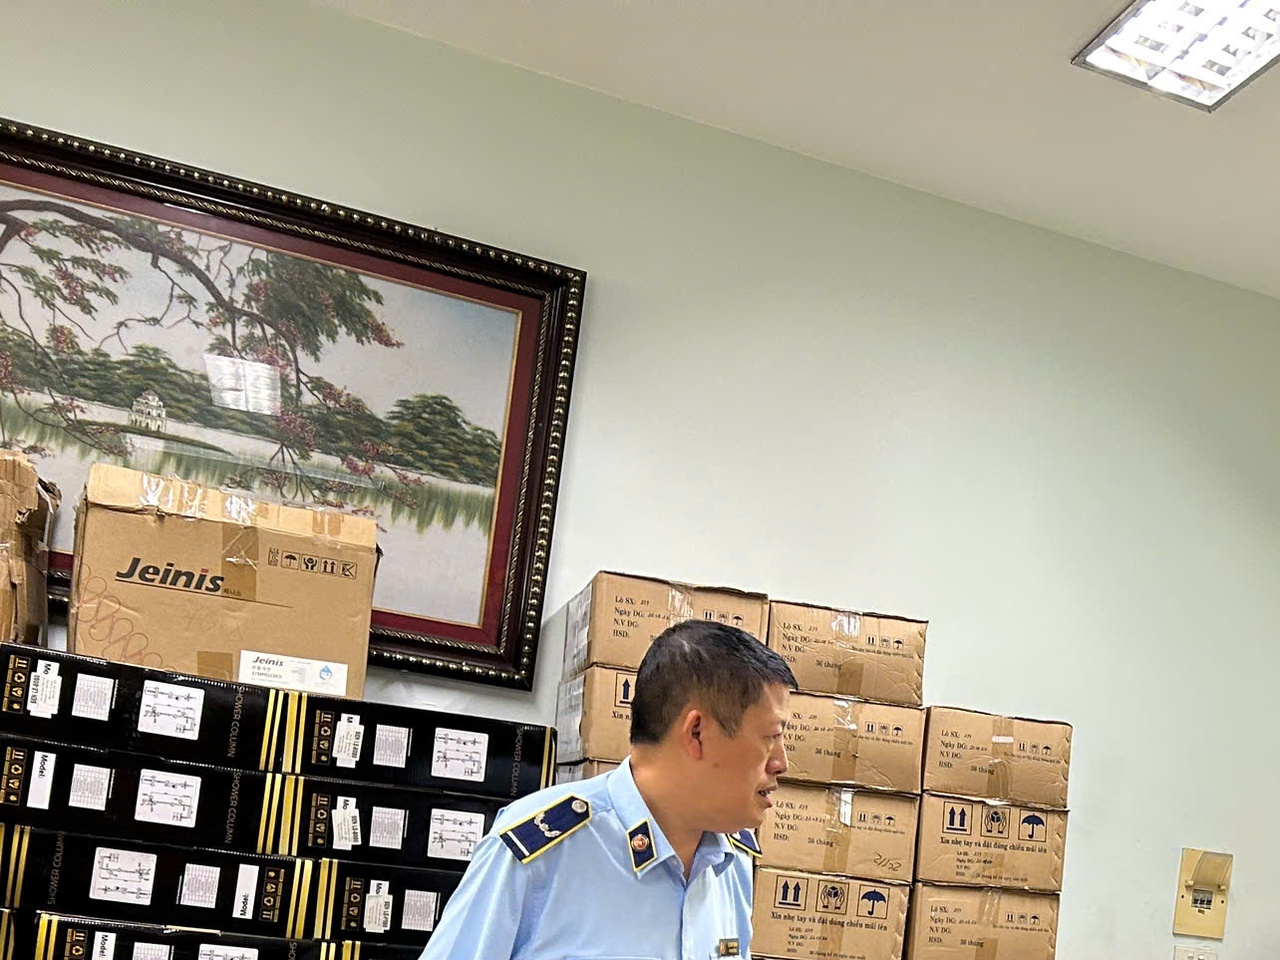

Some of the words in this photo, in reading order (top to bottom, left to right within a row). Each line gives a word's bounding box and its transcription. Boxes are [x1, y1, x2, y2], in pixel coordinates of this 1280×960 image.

[115, 556, 224, 594] Jeinis
[252, 656, 283, 666] Jeinis
[38, 754, 49, 778] Model:
[240, 894, 249, 916] Model:
[99, 934, 108, 958] Model:
